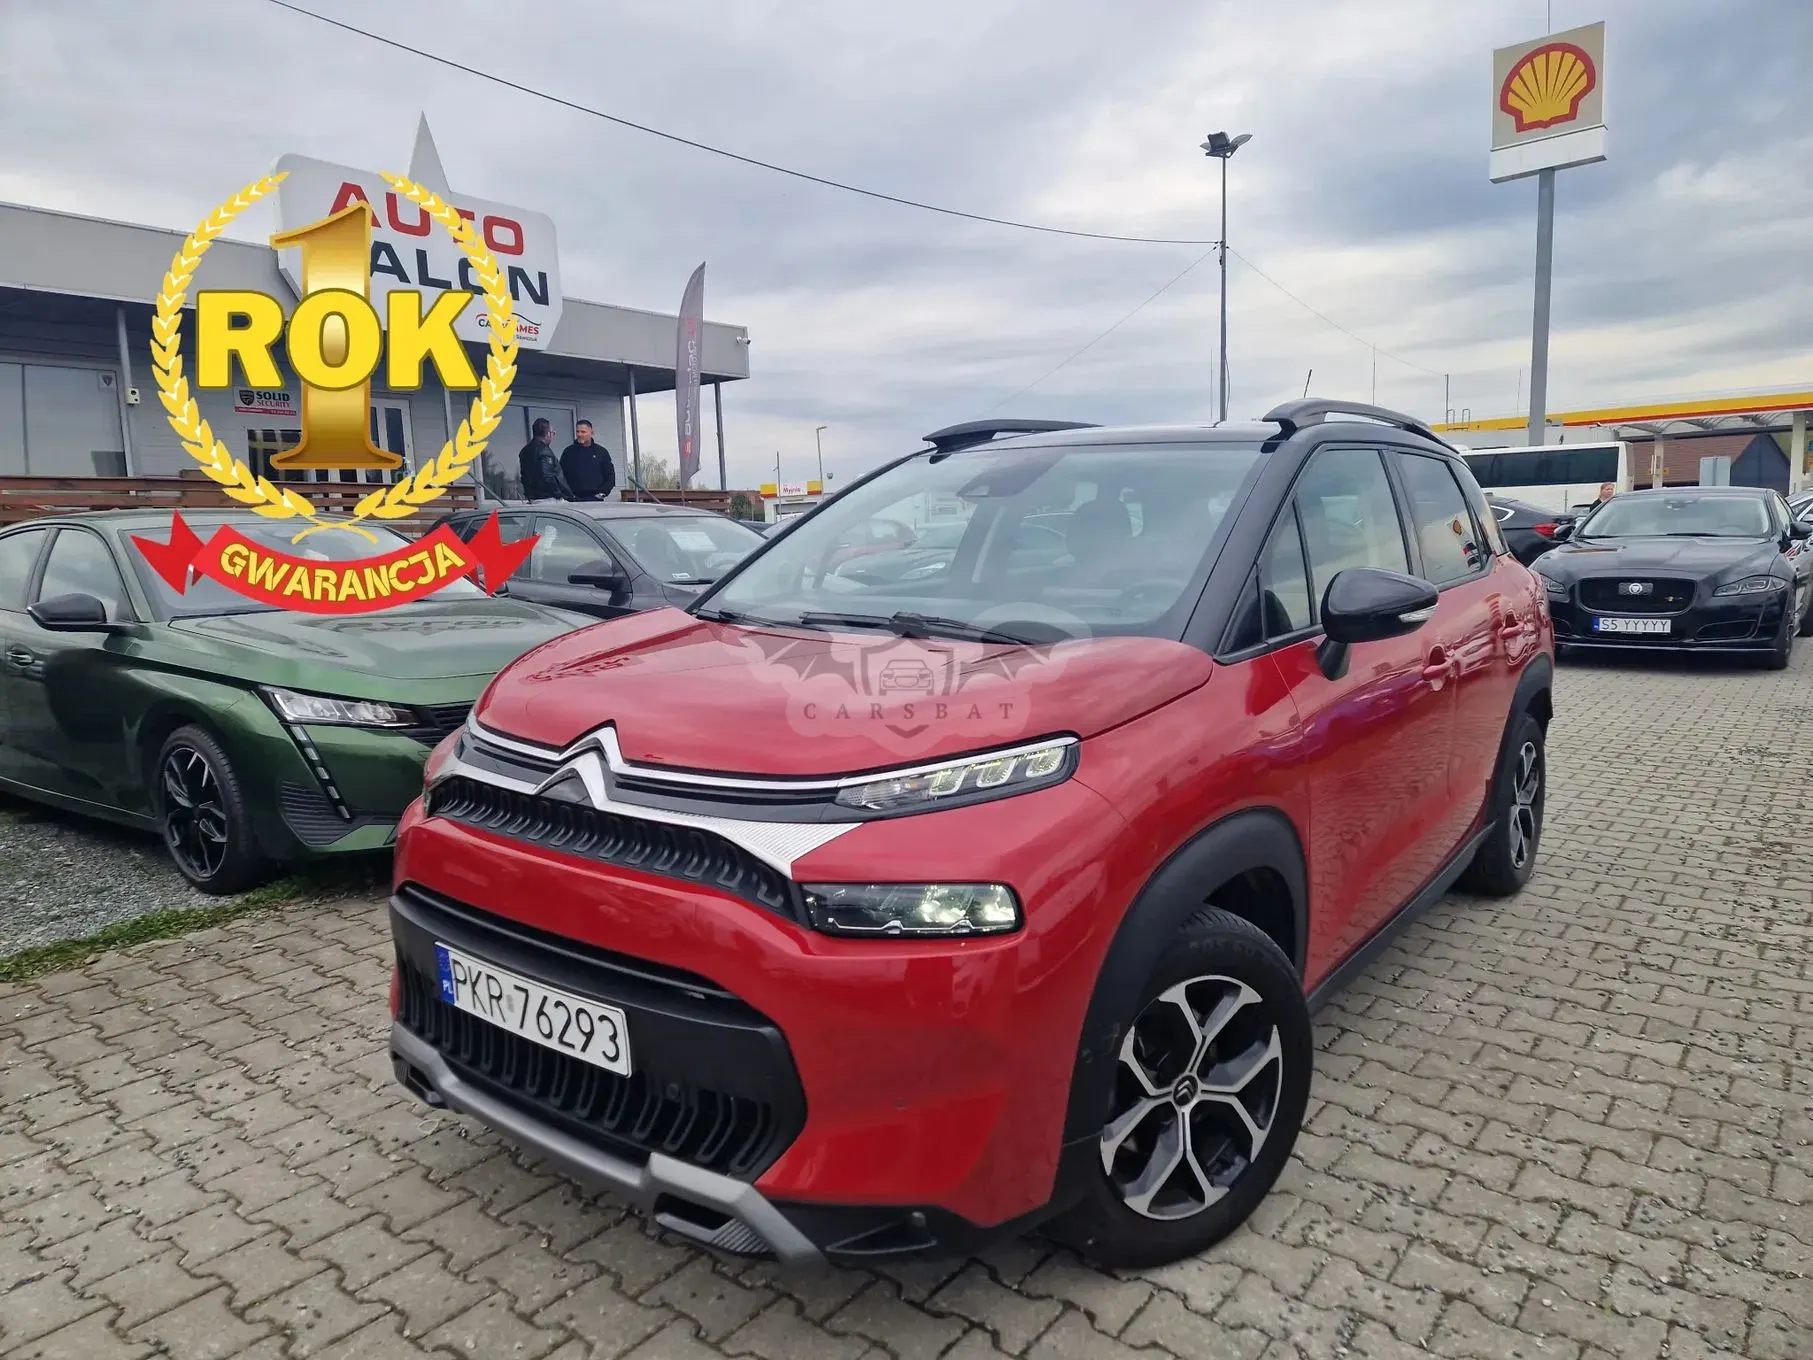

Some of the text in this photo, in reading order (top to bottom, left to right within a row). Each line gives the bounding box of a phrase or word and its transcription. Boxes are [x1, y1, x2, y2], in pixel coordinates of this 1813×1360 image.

[369, 239, 550, 307] ALON
[256, 390, 290, 402] SOLID
[257, 400, 290, 408] SECURITY
[1602, 619, 1668, 632] S5 YYYYY
[442, 979, 454, 995] PL
[453, 958, 621, 1063] PKR 76293
